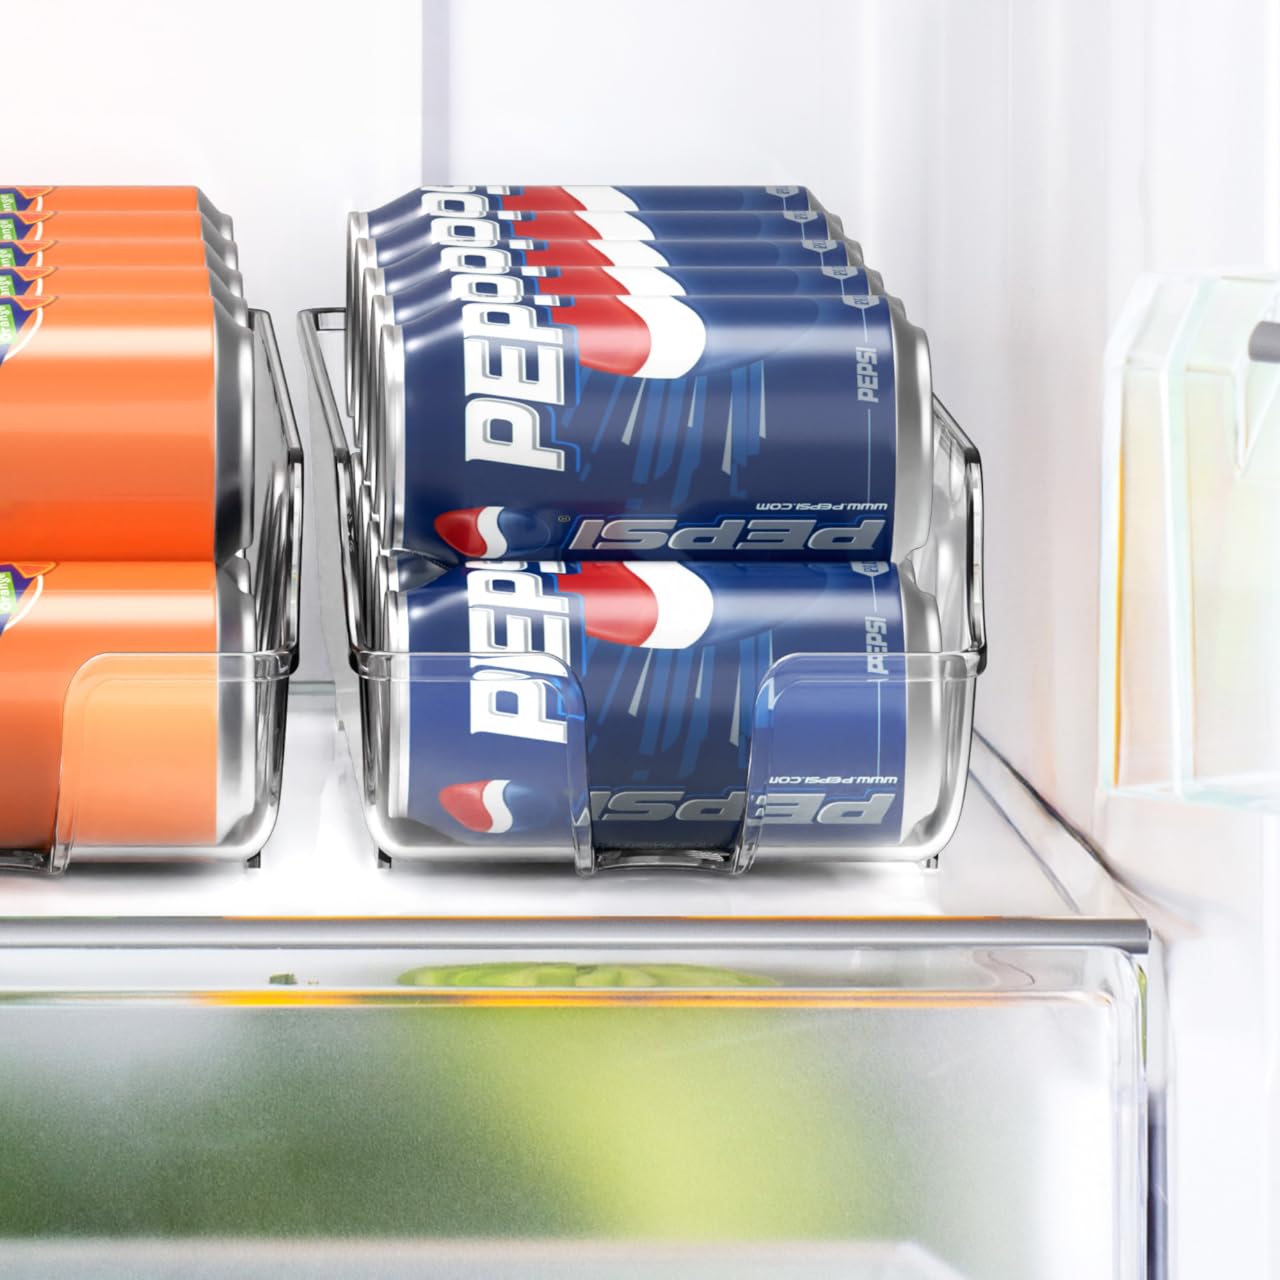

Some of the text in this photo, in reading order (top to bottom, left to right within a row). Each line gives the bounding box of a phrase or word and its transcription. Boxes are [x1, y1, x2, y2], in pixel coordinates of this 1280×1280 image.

[460, 296, 566, 472] PEP
[855, 346, 880, 404] PEPSI
[568, 518, 886, 550] PEPSI
[465, 561, 571, 745] PEP
